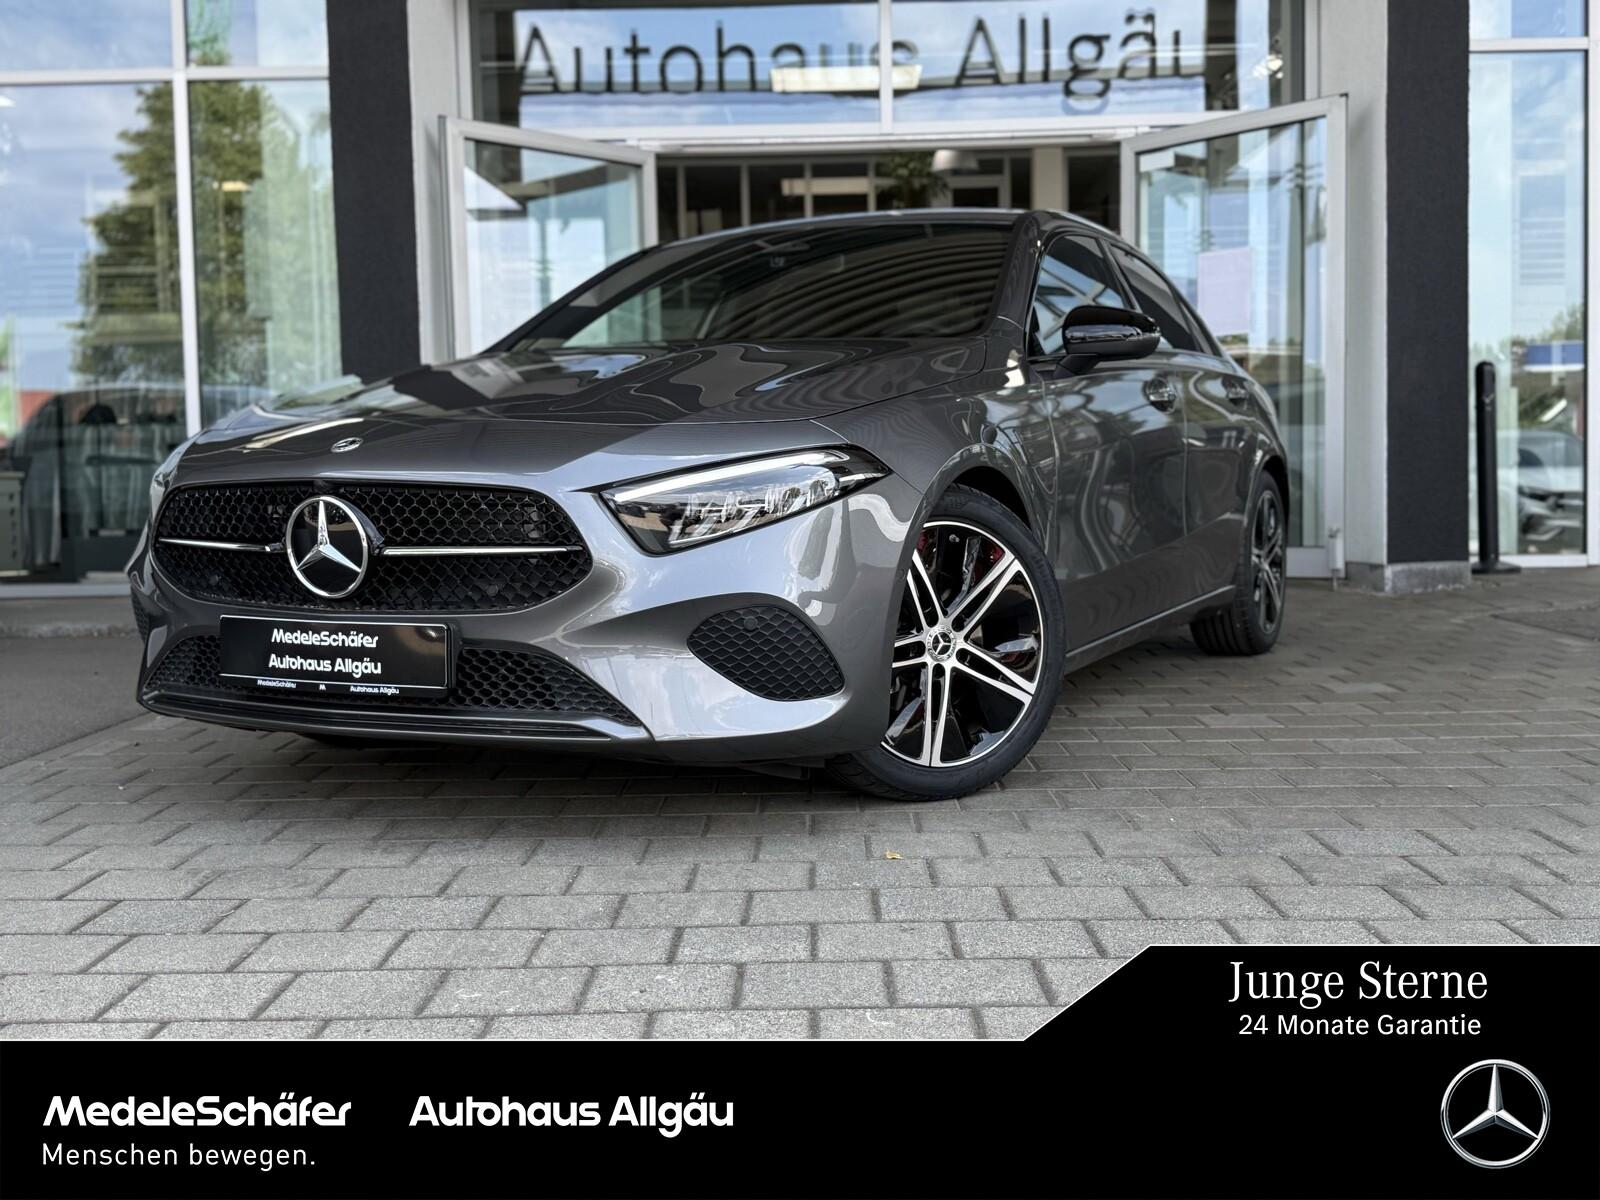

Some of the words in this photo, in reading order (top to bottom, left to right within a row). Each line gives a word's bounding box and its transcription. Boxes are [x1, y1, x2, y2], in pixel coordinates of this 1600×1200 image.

[271, 628, 379, 648] MedeleSchäfer
[268, 653, 332, 672] Autohaus
[334, 657, 382, 678] Allgäu
[350, 685, 379, 694] Autohaus
[379, 686, 400, 696] Allgäu
